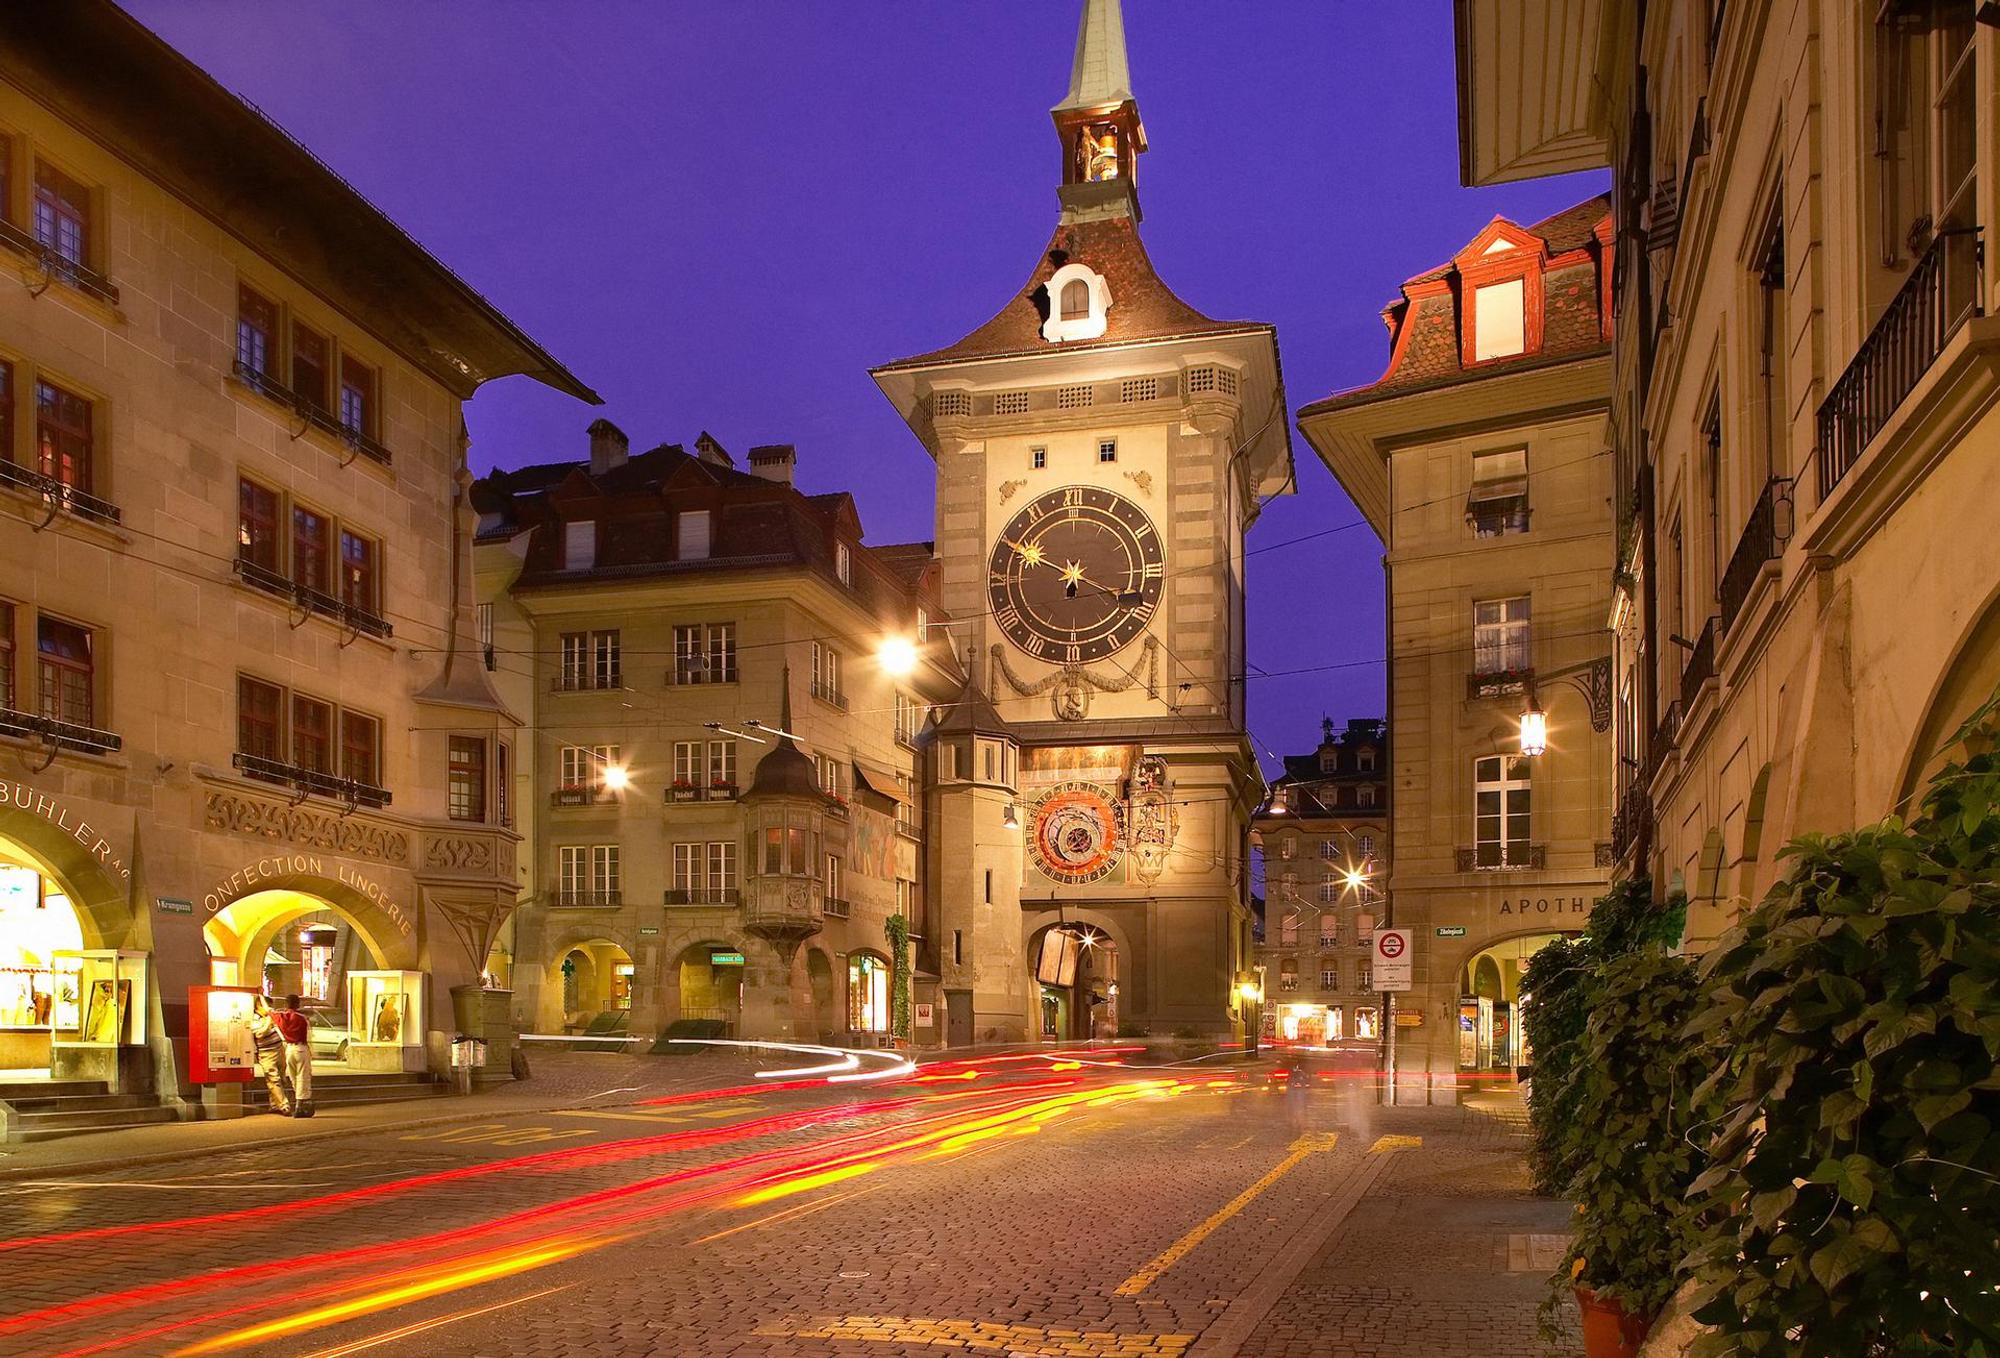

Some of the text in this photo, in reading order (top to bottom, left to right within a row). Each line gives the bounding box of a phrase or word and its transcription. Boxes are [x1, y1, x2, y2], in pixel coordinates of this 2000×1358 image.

[1062, 488, 1083, 507] XII
[1145, 562, 1163, 578] III
[0, 781, 111, 862] BÜHLER
[204, 854, 412, 937] ONFECTION LINGERIE
